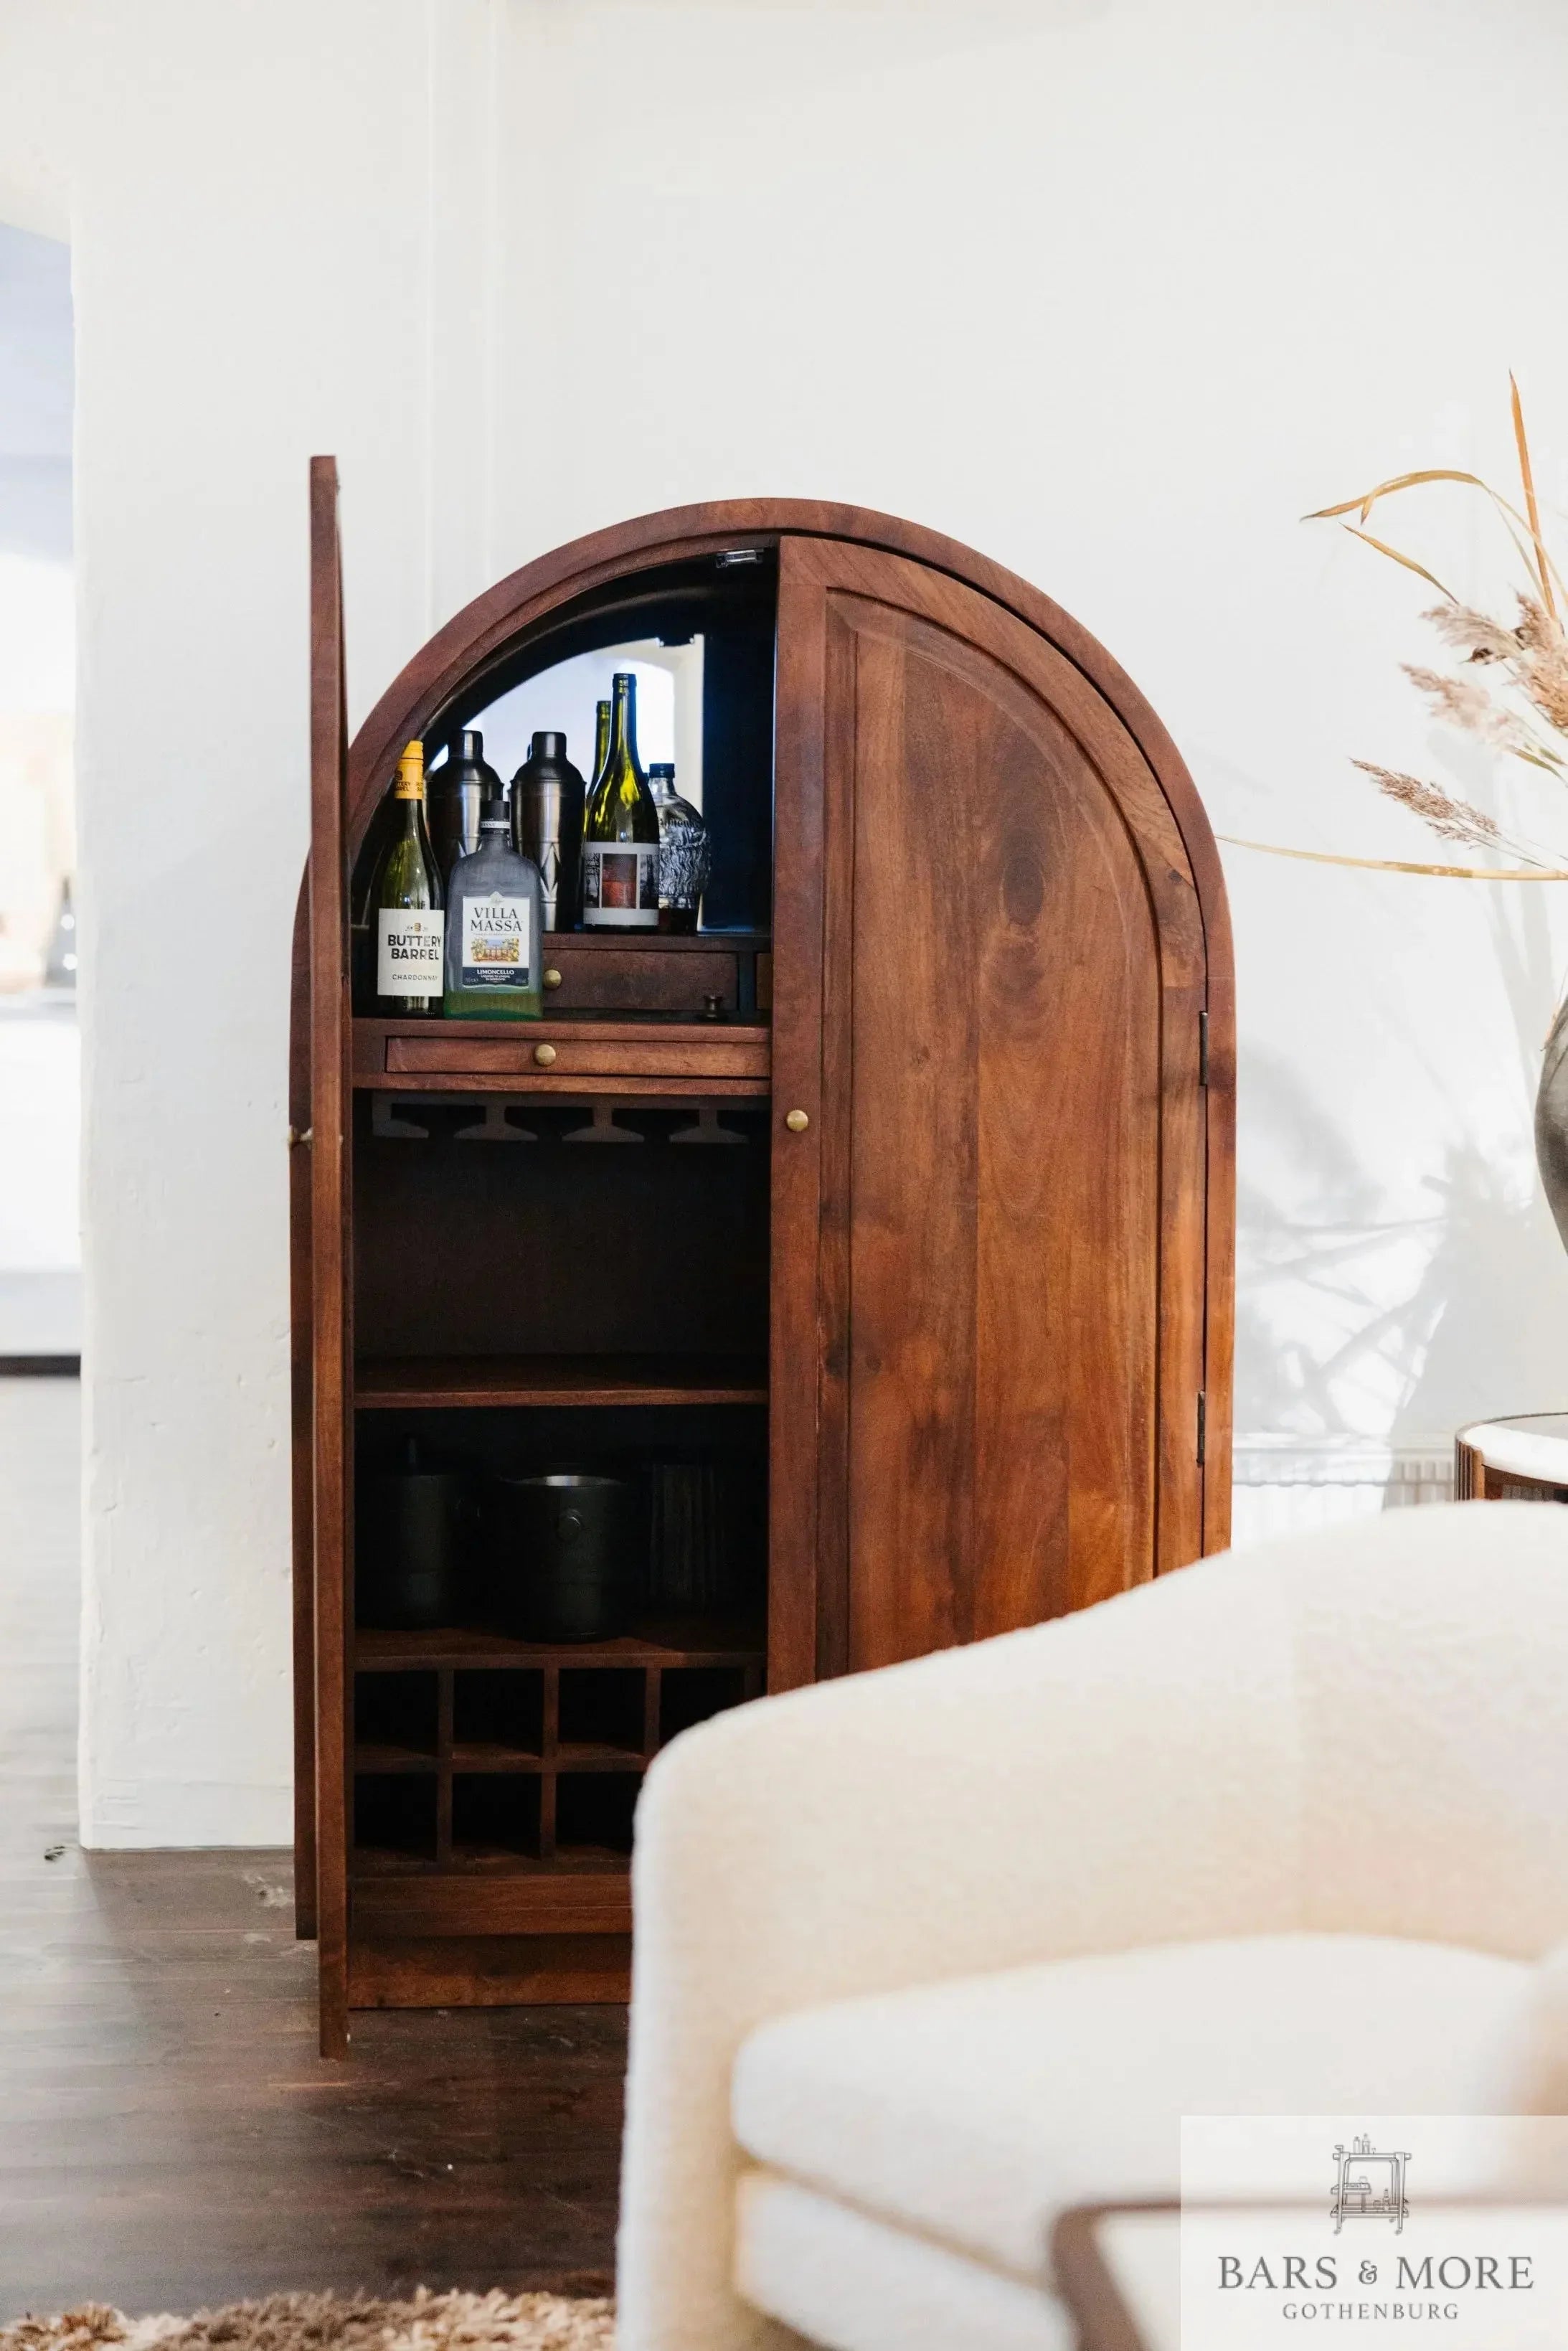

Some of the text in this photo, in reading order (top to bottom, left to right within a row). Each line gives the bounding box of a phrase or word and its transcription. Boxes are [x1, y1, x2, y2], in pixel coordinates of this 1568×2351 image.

[473, 908, 518, 919] VILLA
[471, 919, 522, 931] MASSA
[387, 934, 441, 947] BUTTERY
[391, 948, 439, 960] BARREL
